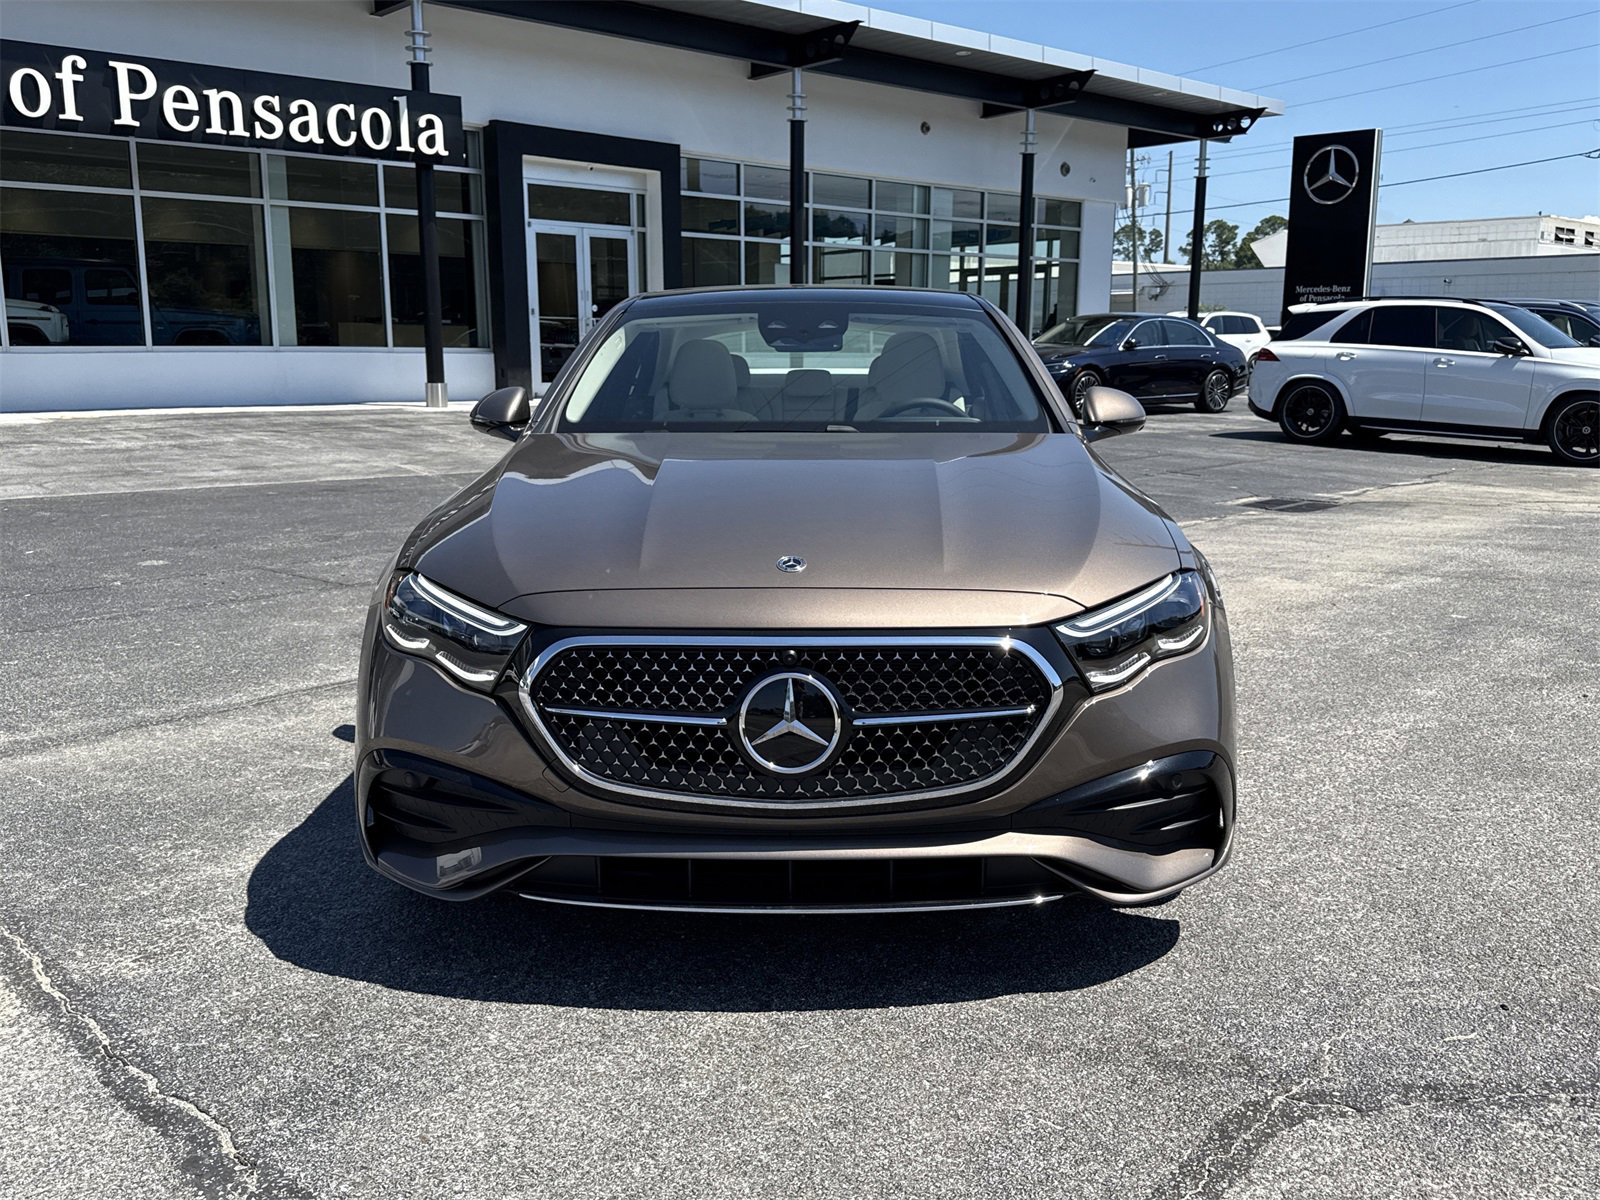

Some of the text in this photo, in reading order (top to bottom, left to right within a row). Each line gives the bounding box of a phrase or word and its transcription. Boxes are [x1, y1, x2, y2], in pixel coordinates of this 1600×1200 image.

[9, 54, 449, 156] of Pensacola
[1295, 285, 1351, 293] Mercedes-Benz
[1299, 294, 1307, 302] of
